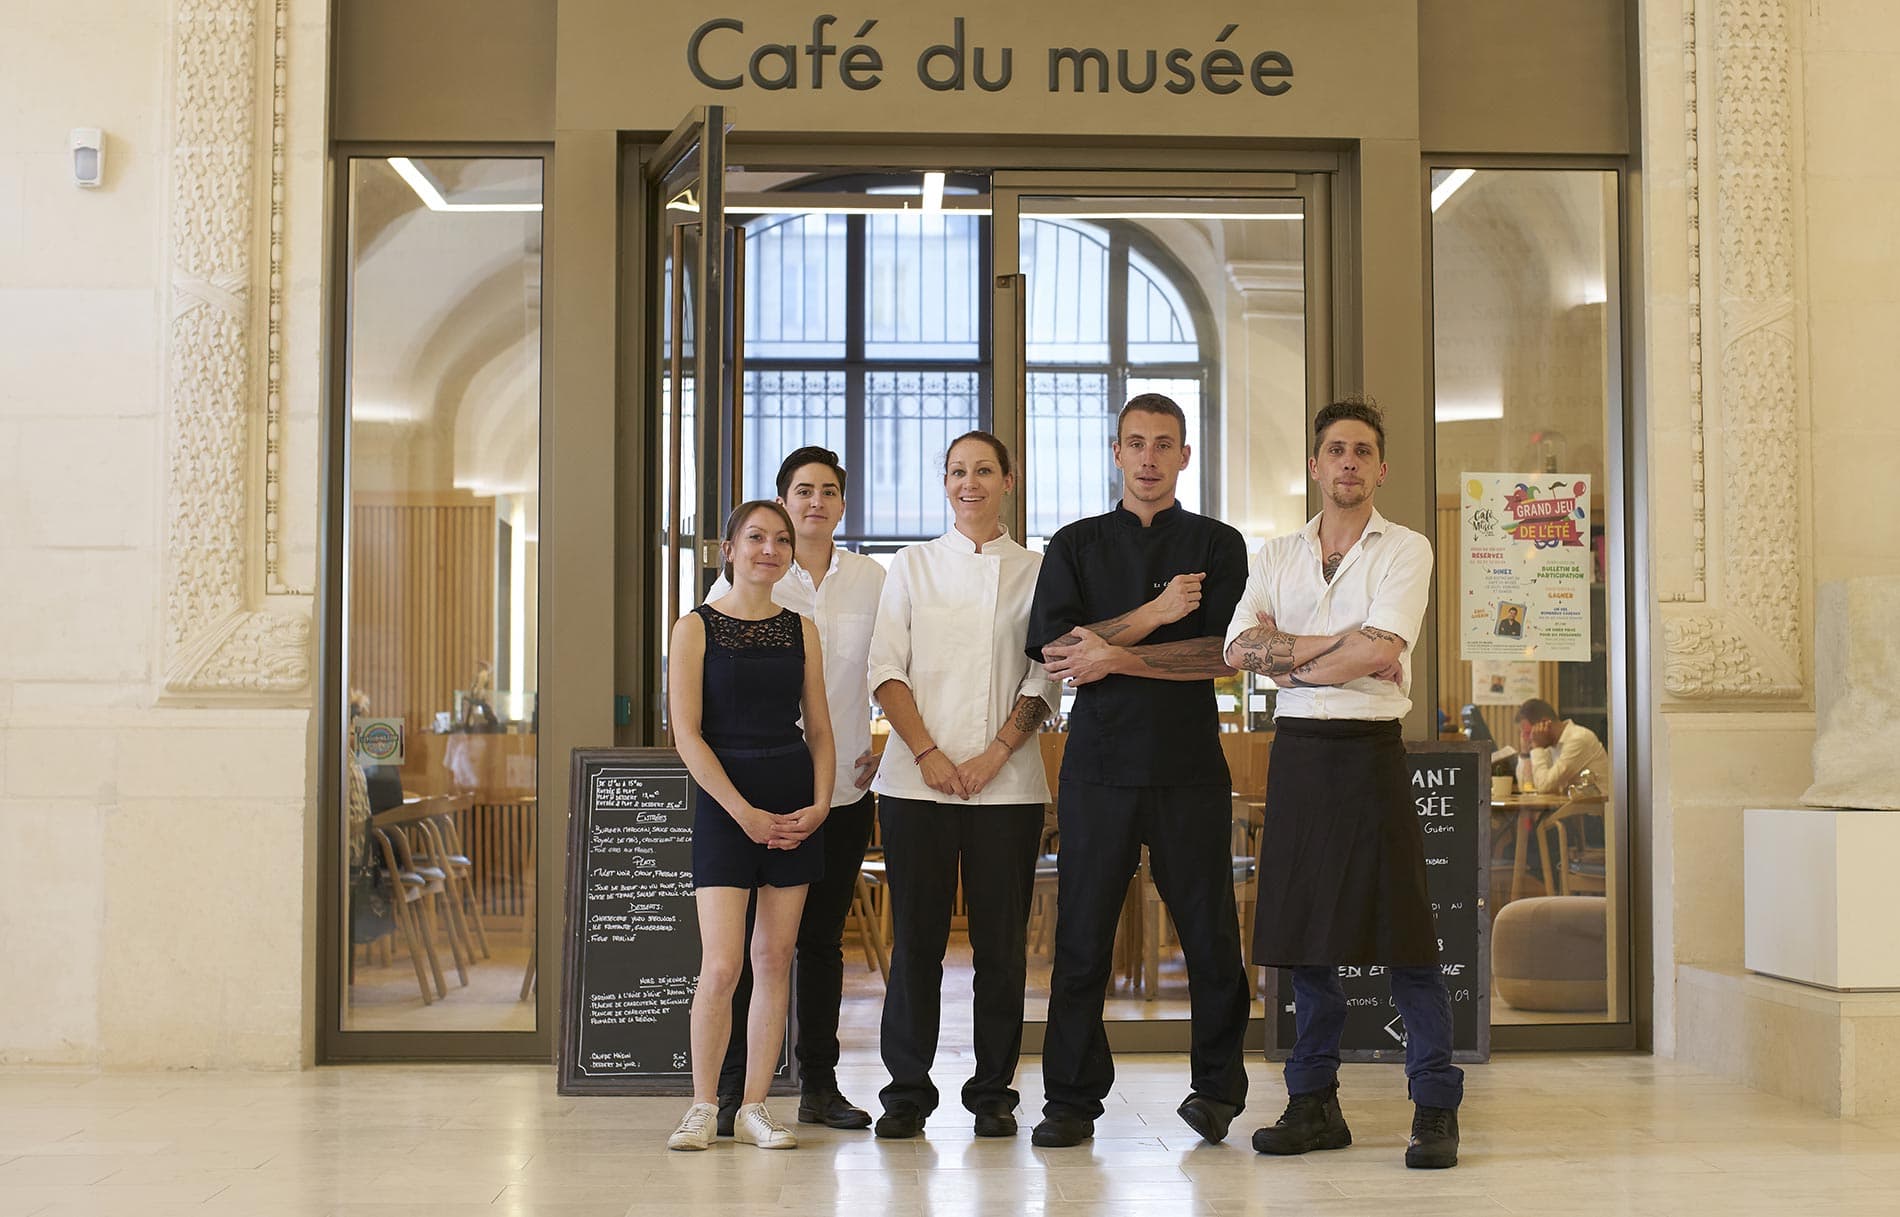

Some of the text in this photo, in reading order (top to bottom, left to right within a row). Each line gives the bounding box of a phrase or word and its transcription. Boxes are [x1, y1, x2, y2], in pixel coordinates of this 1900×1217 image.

[687, 14, 1295, 96] Café du musée
[1516, 500, 1574, 518] GRAND JEU
[1520, 525, 1536, 538] DE
[1411, 767, 1461, 788] ANT
[1415, 791, 1455, 816] SÉE
[1450, 902, 1463, 910] AU
[1338, 964, 1465, 978] EDI ET HE
[1454, 989, 1470, 1002] 09
